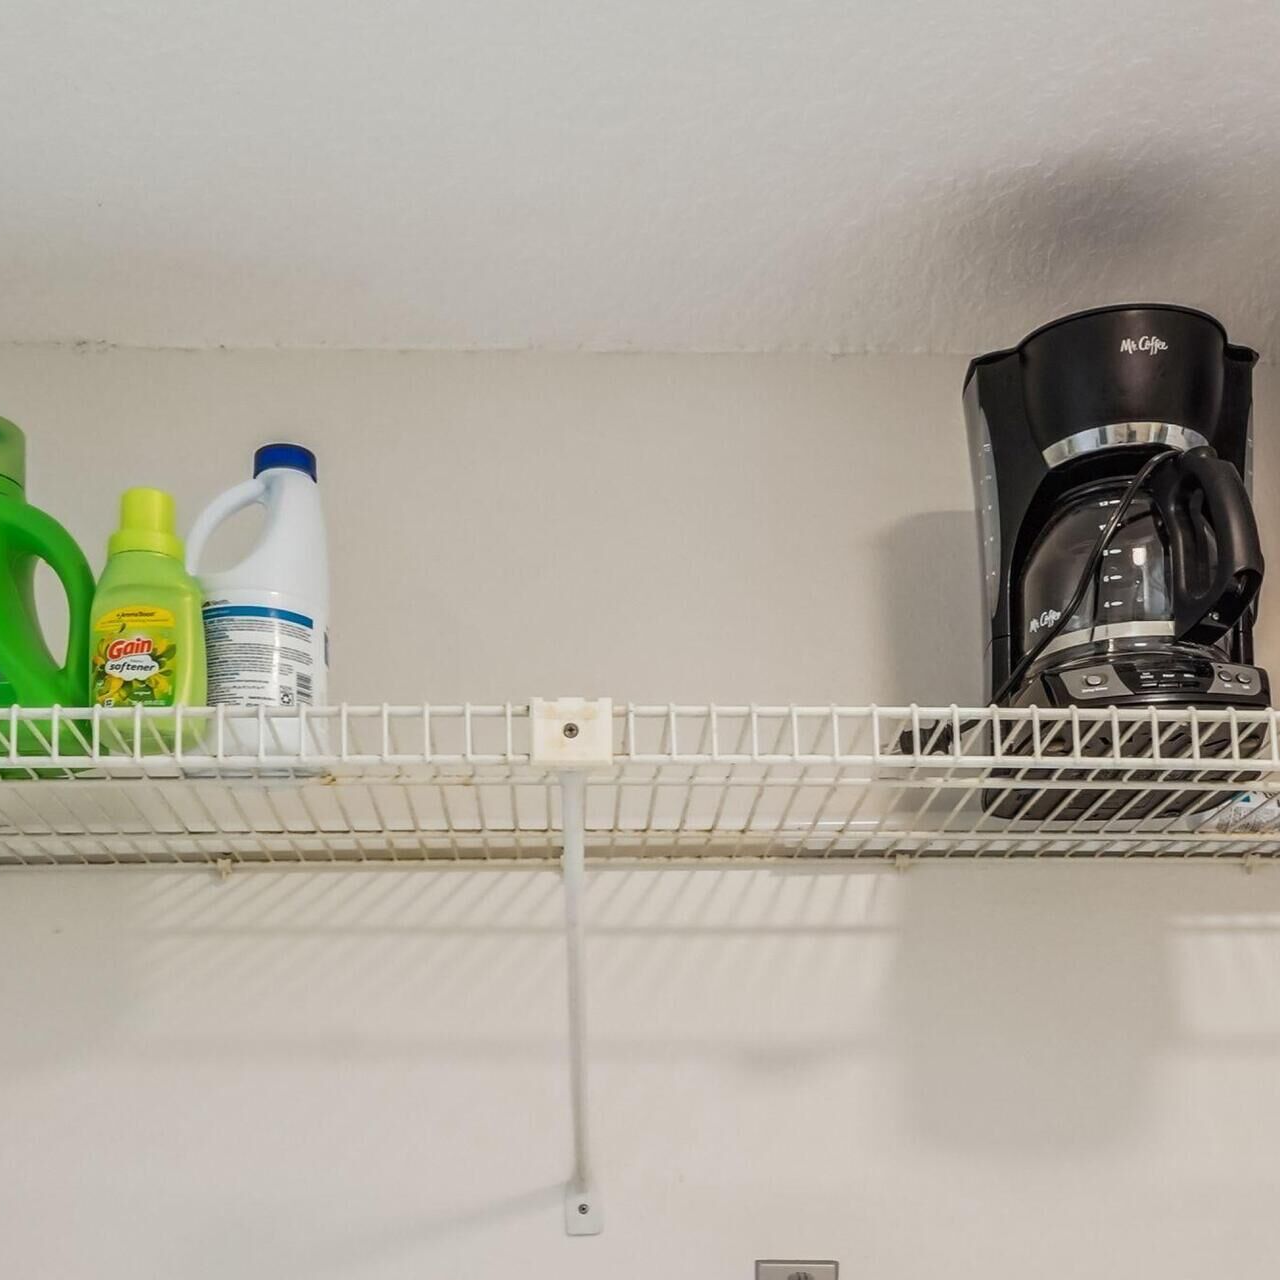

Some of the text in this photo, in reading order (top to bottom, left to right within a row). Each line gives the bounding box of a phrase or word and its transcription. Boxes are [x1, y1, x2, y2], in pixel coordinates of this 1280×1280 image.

[1138, 335, 1169, 356] Coffee
[108, 638, 153, 661] Gain
[108, 662, 156, 673] softener
